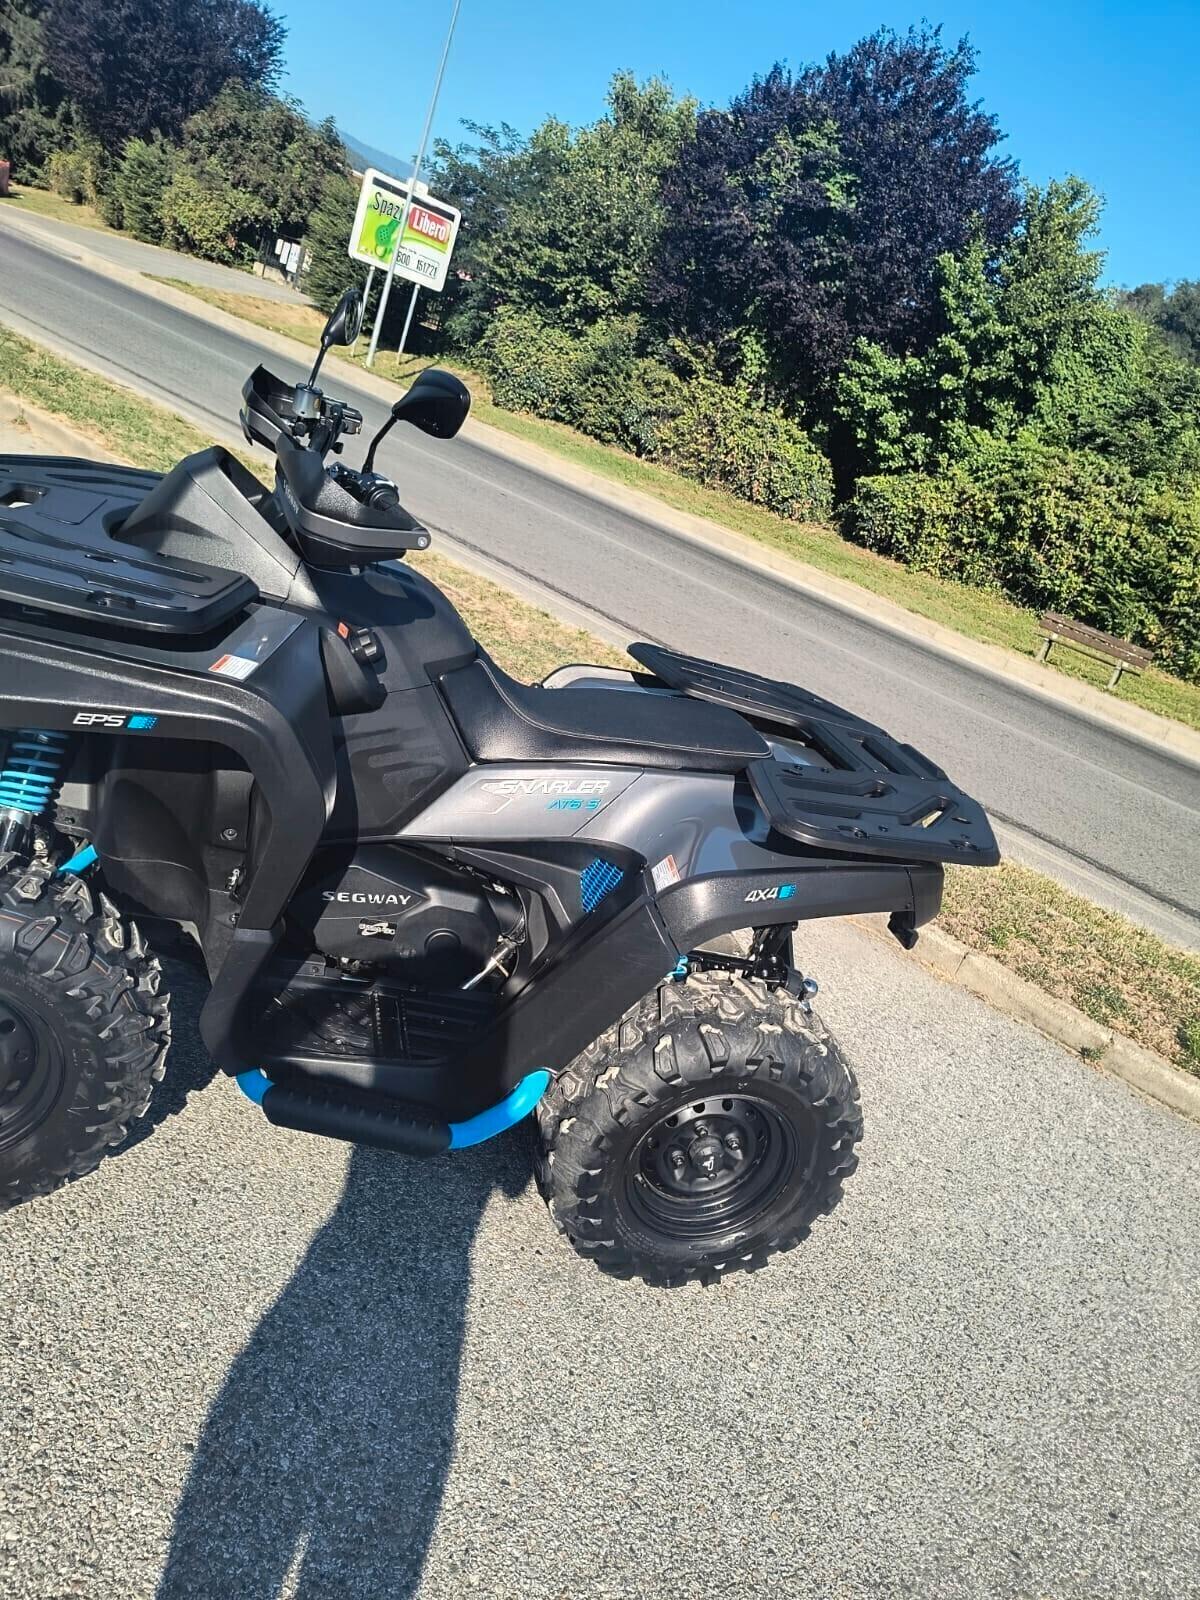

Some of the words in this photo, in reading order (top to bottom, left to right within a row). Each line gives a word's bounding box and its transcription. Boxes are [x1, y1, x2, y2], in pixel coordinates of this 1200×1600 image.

[373, 192, 406, 221] Spazi
[412, 209, 447, 241] Libero
[72, 712, 127, 727] EPS
[497, 779, 611, 795] SNARLER
[547, 798, 583, 811] AT6
[585, 798, 602, 811] S
[321, 890, 412, 905] SEGWAY
